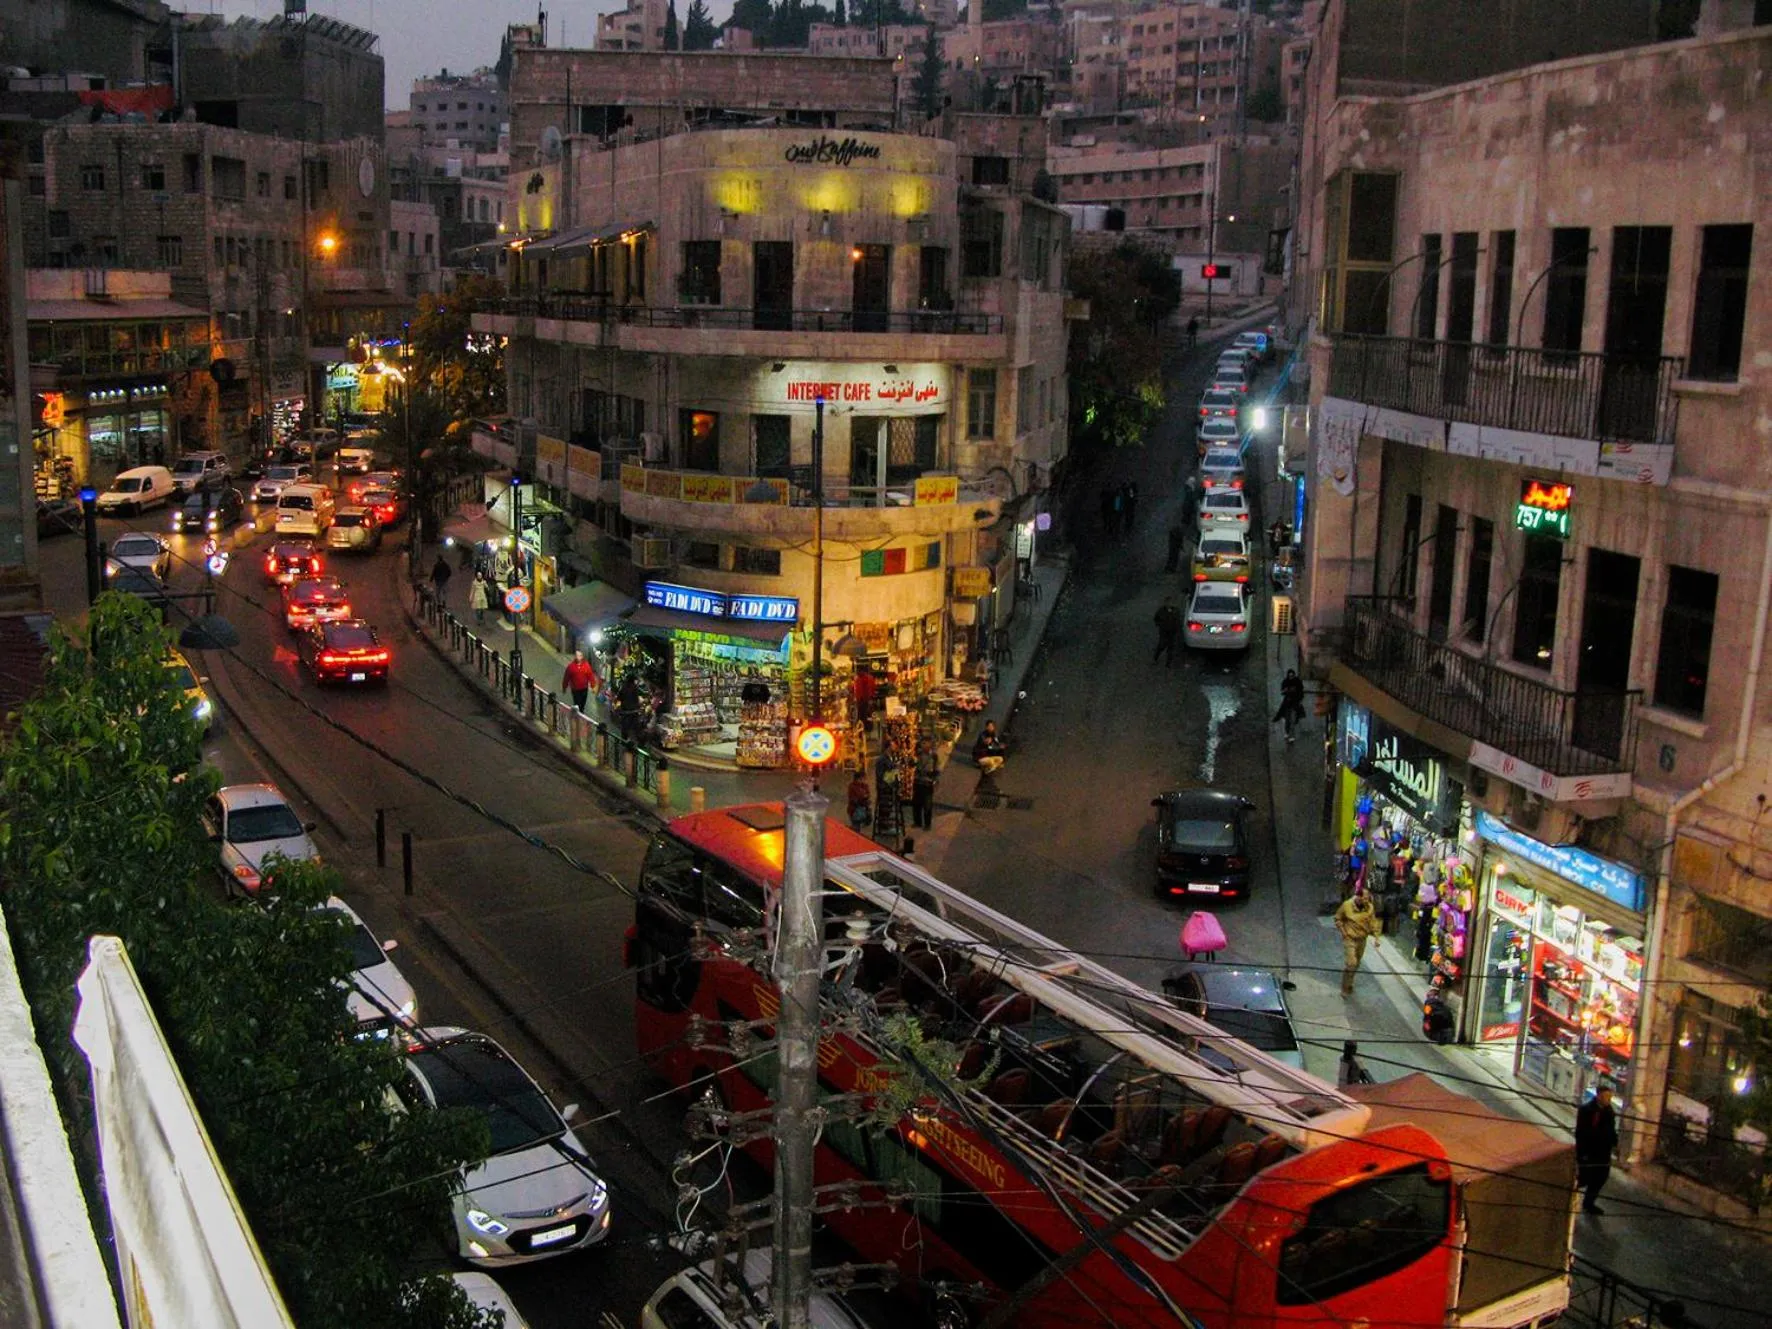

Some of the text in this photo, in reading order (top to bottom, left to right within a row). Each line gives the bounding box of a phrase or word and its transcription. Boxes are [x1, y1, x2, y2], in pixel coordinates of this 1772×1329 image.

[787, 382, 871, 400] INTERNET CAFE
[665, 591, 688, 610] FADI
[689, 596, 711, 614] DVD
[730, 601, 763, 617] FADI
[766, 603, 796, 619] DVD
